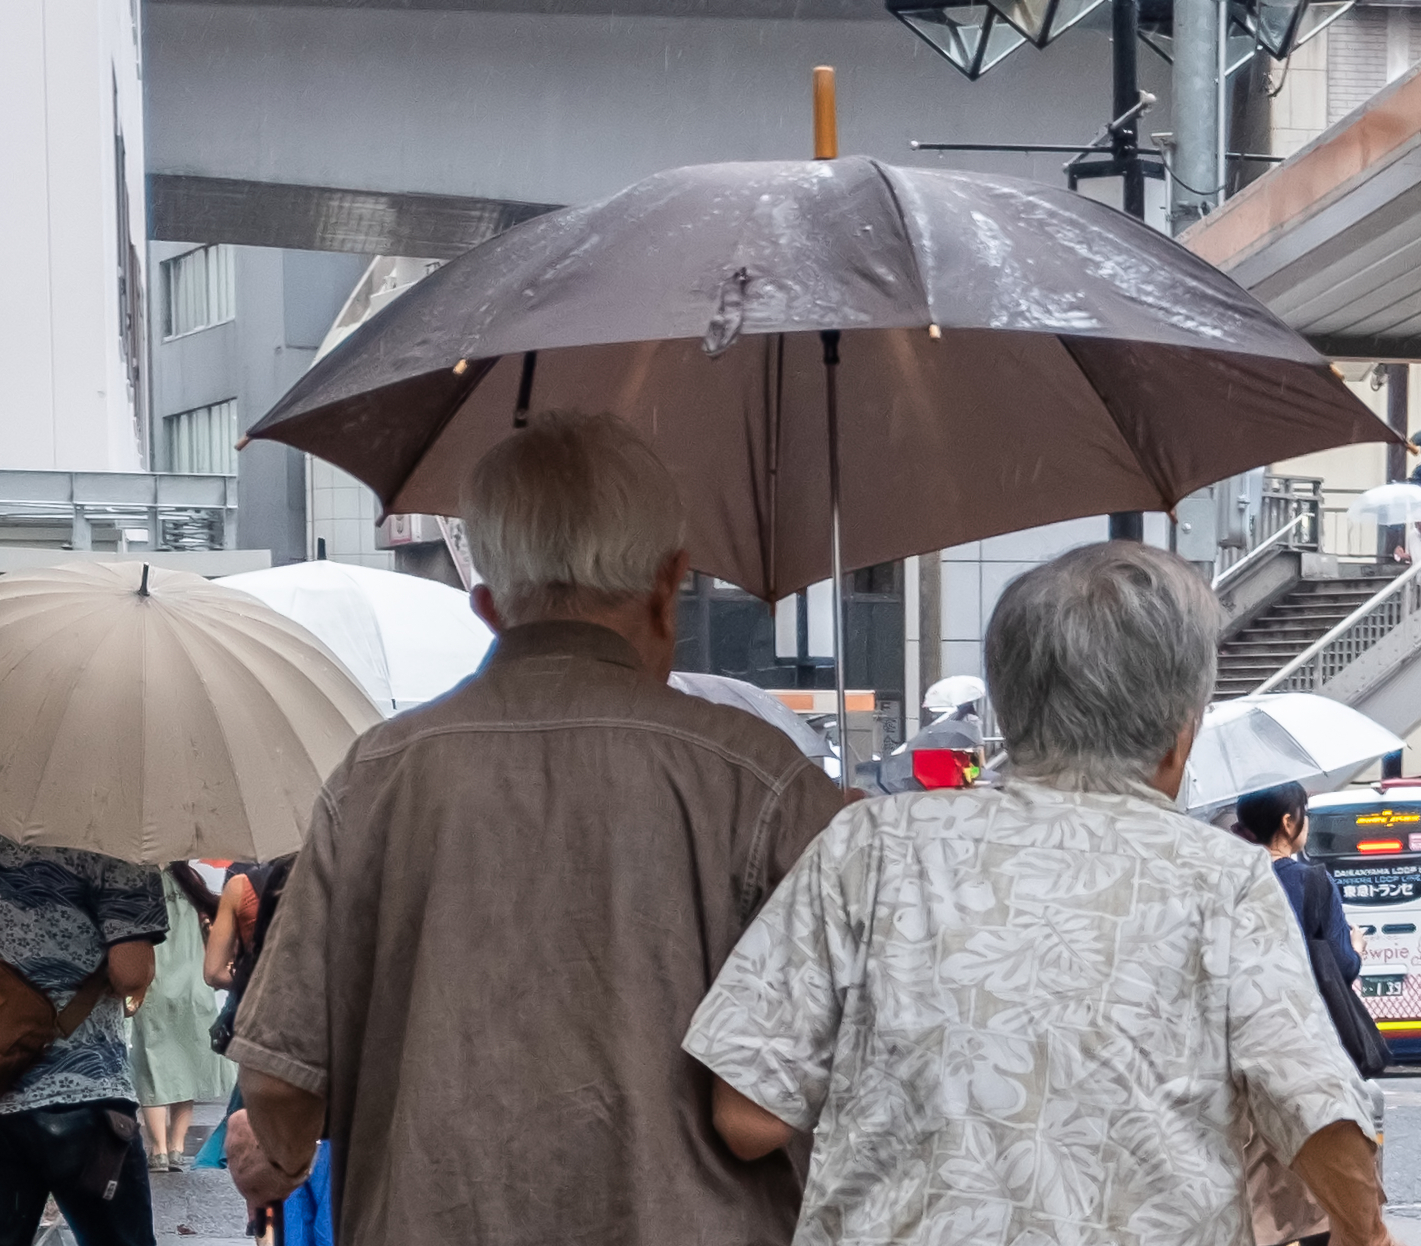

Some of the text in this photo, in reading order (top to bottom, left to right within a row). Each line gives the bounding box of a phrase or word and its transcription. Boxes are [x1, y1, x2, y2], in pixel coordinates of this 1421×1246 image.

[1392, 866, 1417, 875] LOOP
[1343, 883, 1414, 899] 東急トランセ
[1360, 942, 1410, 963] ewpie
